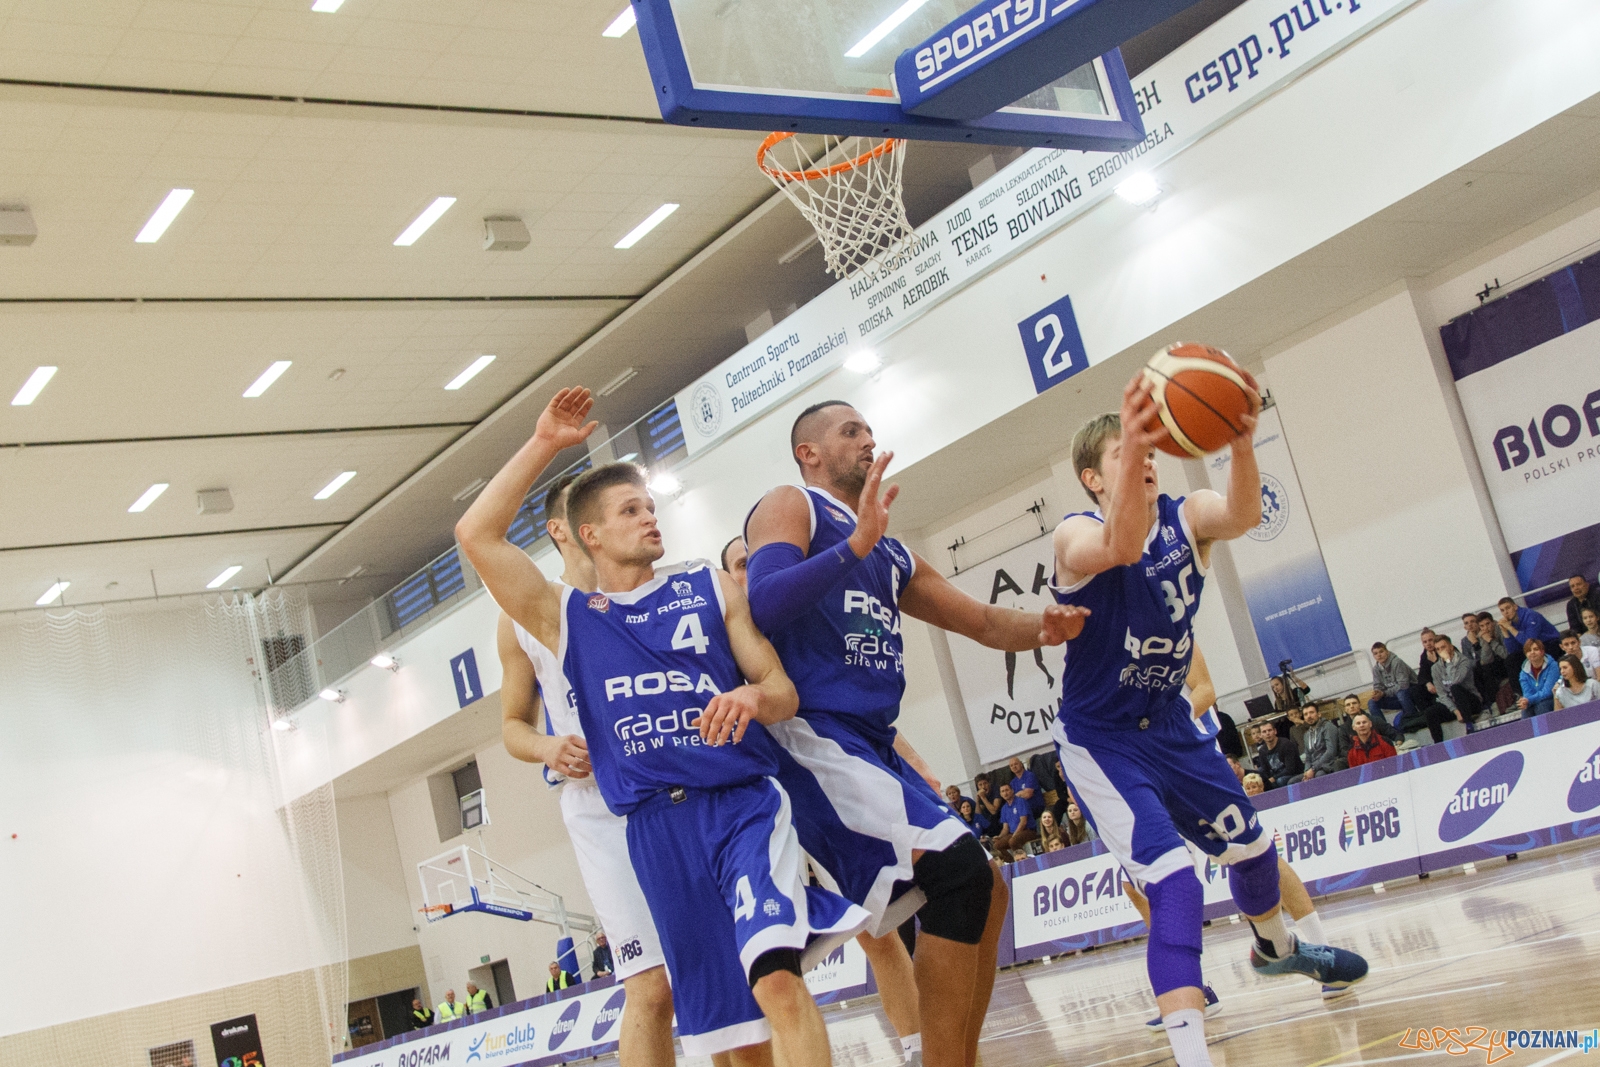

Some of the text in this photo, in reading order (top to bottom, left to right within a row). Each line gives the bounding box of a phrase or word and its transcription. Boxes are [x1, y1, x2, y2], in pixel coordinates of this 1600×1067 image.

[1088, 122, 1174, 187] ERGOWIOSŁA
[1016, 165, 1068, 206] SIŁOWNIA
[946, 208, 972, 234] JUDO
[1006, 177, 1082, 240] BOWLING
[951, 214, 999, 257] TENIS
[849, 230, 939, 300] HALA SPORTOWA
[915, 251, 942, 276] SZACHY
[965, 244, 992, 267] KARATE
[901, 267, 950, 310] AEROBIK
[858, 306, 893, 337] BOISKA
[725, 332, 800, 388] Centrum Sportu
[1035, 313, 1072, 379] 2
[731, 368, 786, 413] Politechniki
[787, 327, 849, 378] Poznańskiej
[1524, 457, 1570, 484] POLSKI
[657, 595, 706, 615] ROSA
[671, 613, 710, 655] 4
[1124, 626, 1191, 660] ROS
[458, 658, 474, 700] 1
[605, 670, 722, 702] ROSA
[990, 697, 1064, 735] POZN
[1354, 796, 1398, 814] fundacja
[1449, 781, 1509, 814] atrem
[1283, 815, 1325, 832] fundacja
[1356, 806, 1401, 847] PBG
[1285, 825, 1327, 863] PBG
[735, 875, 756, 923] 4
[1044, 916, 1070, 929] POLSKI
[1073, 903, 1120, 922] PRODUCENT
[485, 1022, 536, 1053] funclub
[485, 1047, 504, 1059] biuro
